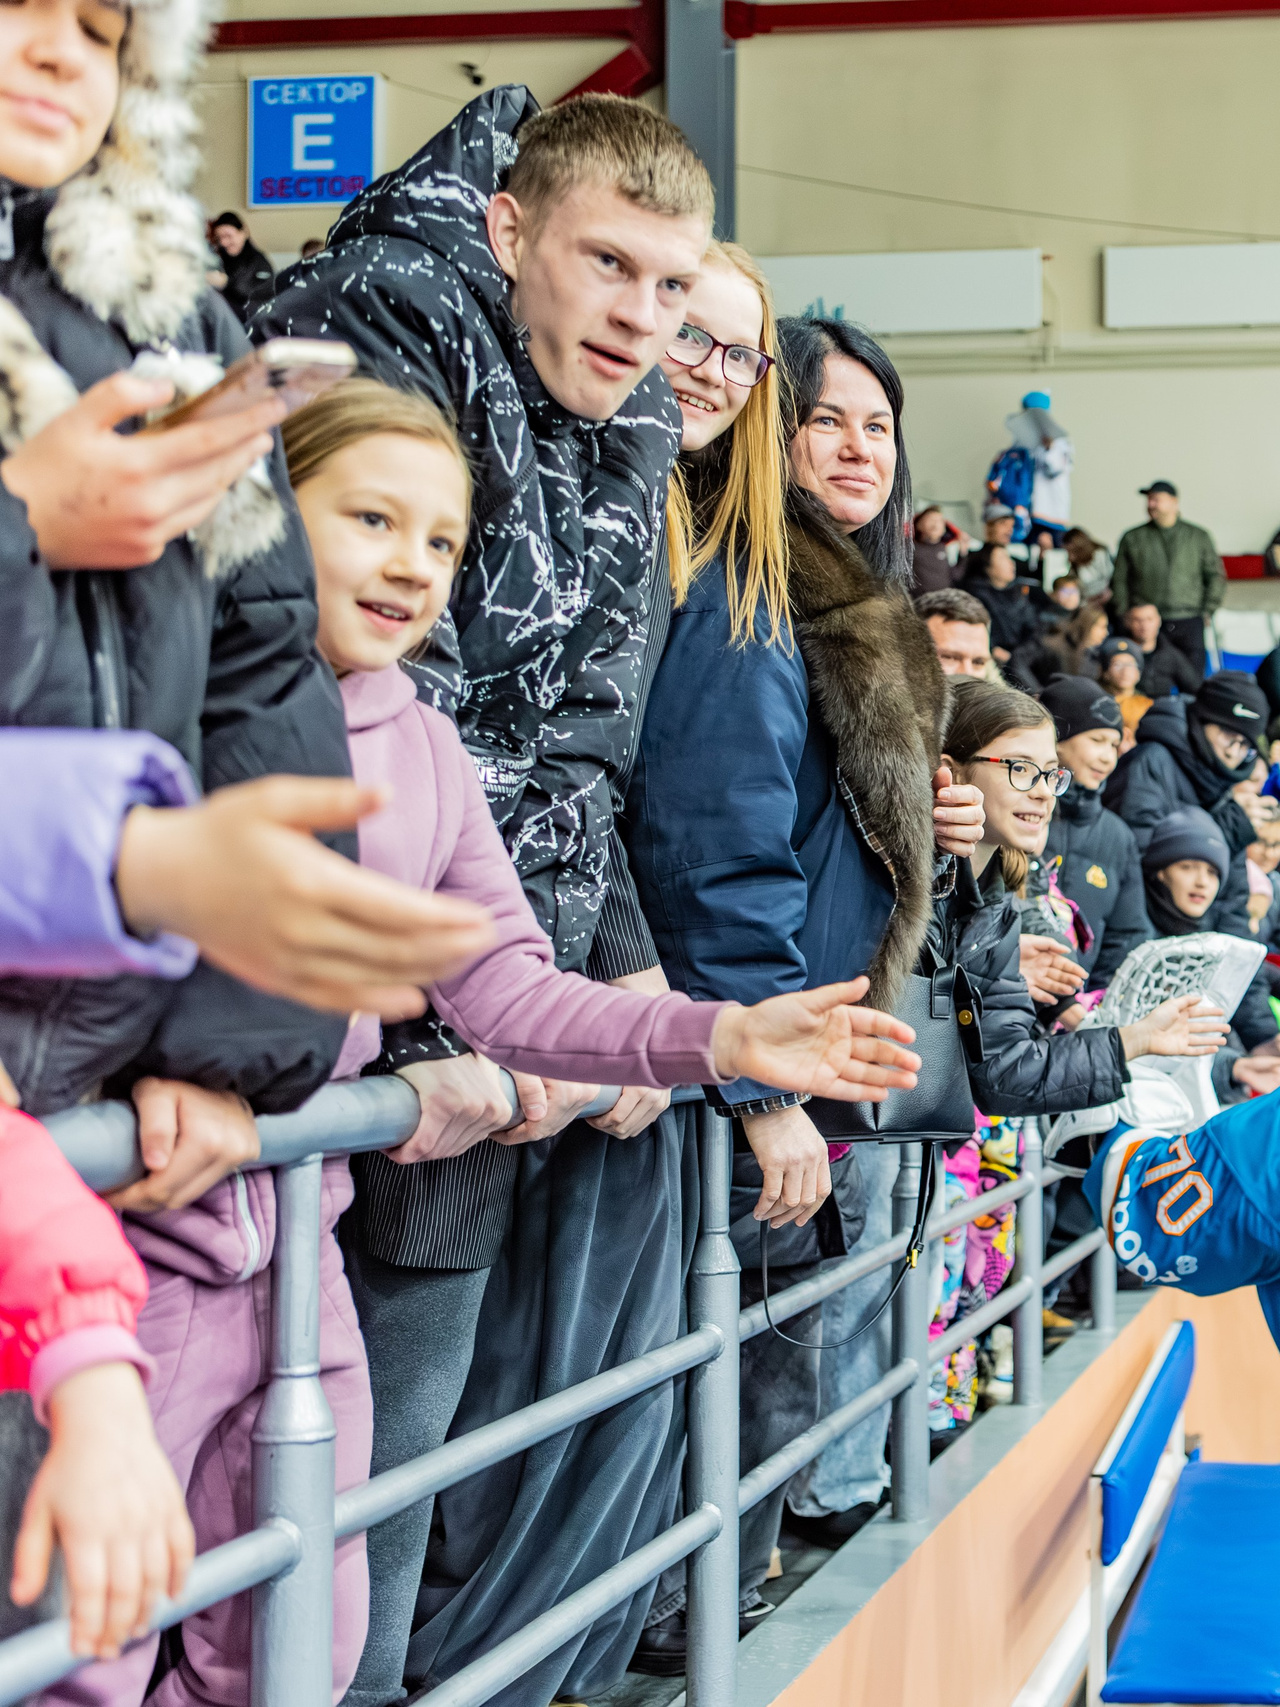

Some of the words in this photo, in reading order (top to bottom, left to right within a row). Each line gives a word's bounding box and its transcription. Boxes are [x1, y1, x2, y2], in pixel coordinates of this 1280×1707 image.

[262, 82, 367, 105] СЕКТОР
[261, 176, 365, 198] SECTOR
[472, 756, 495, 766] NCE
[1142, 1134, 1213, 1236] 70
